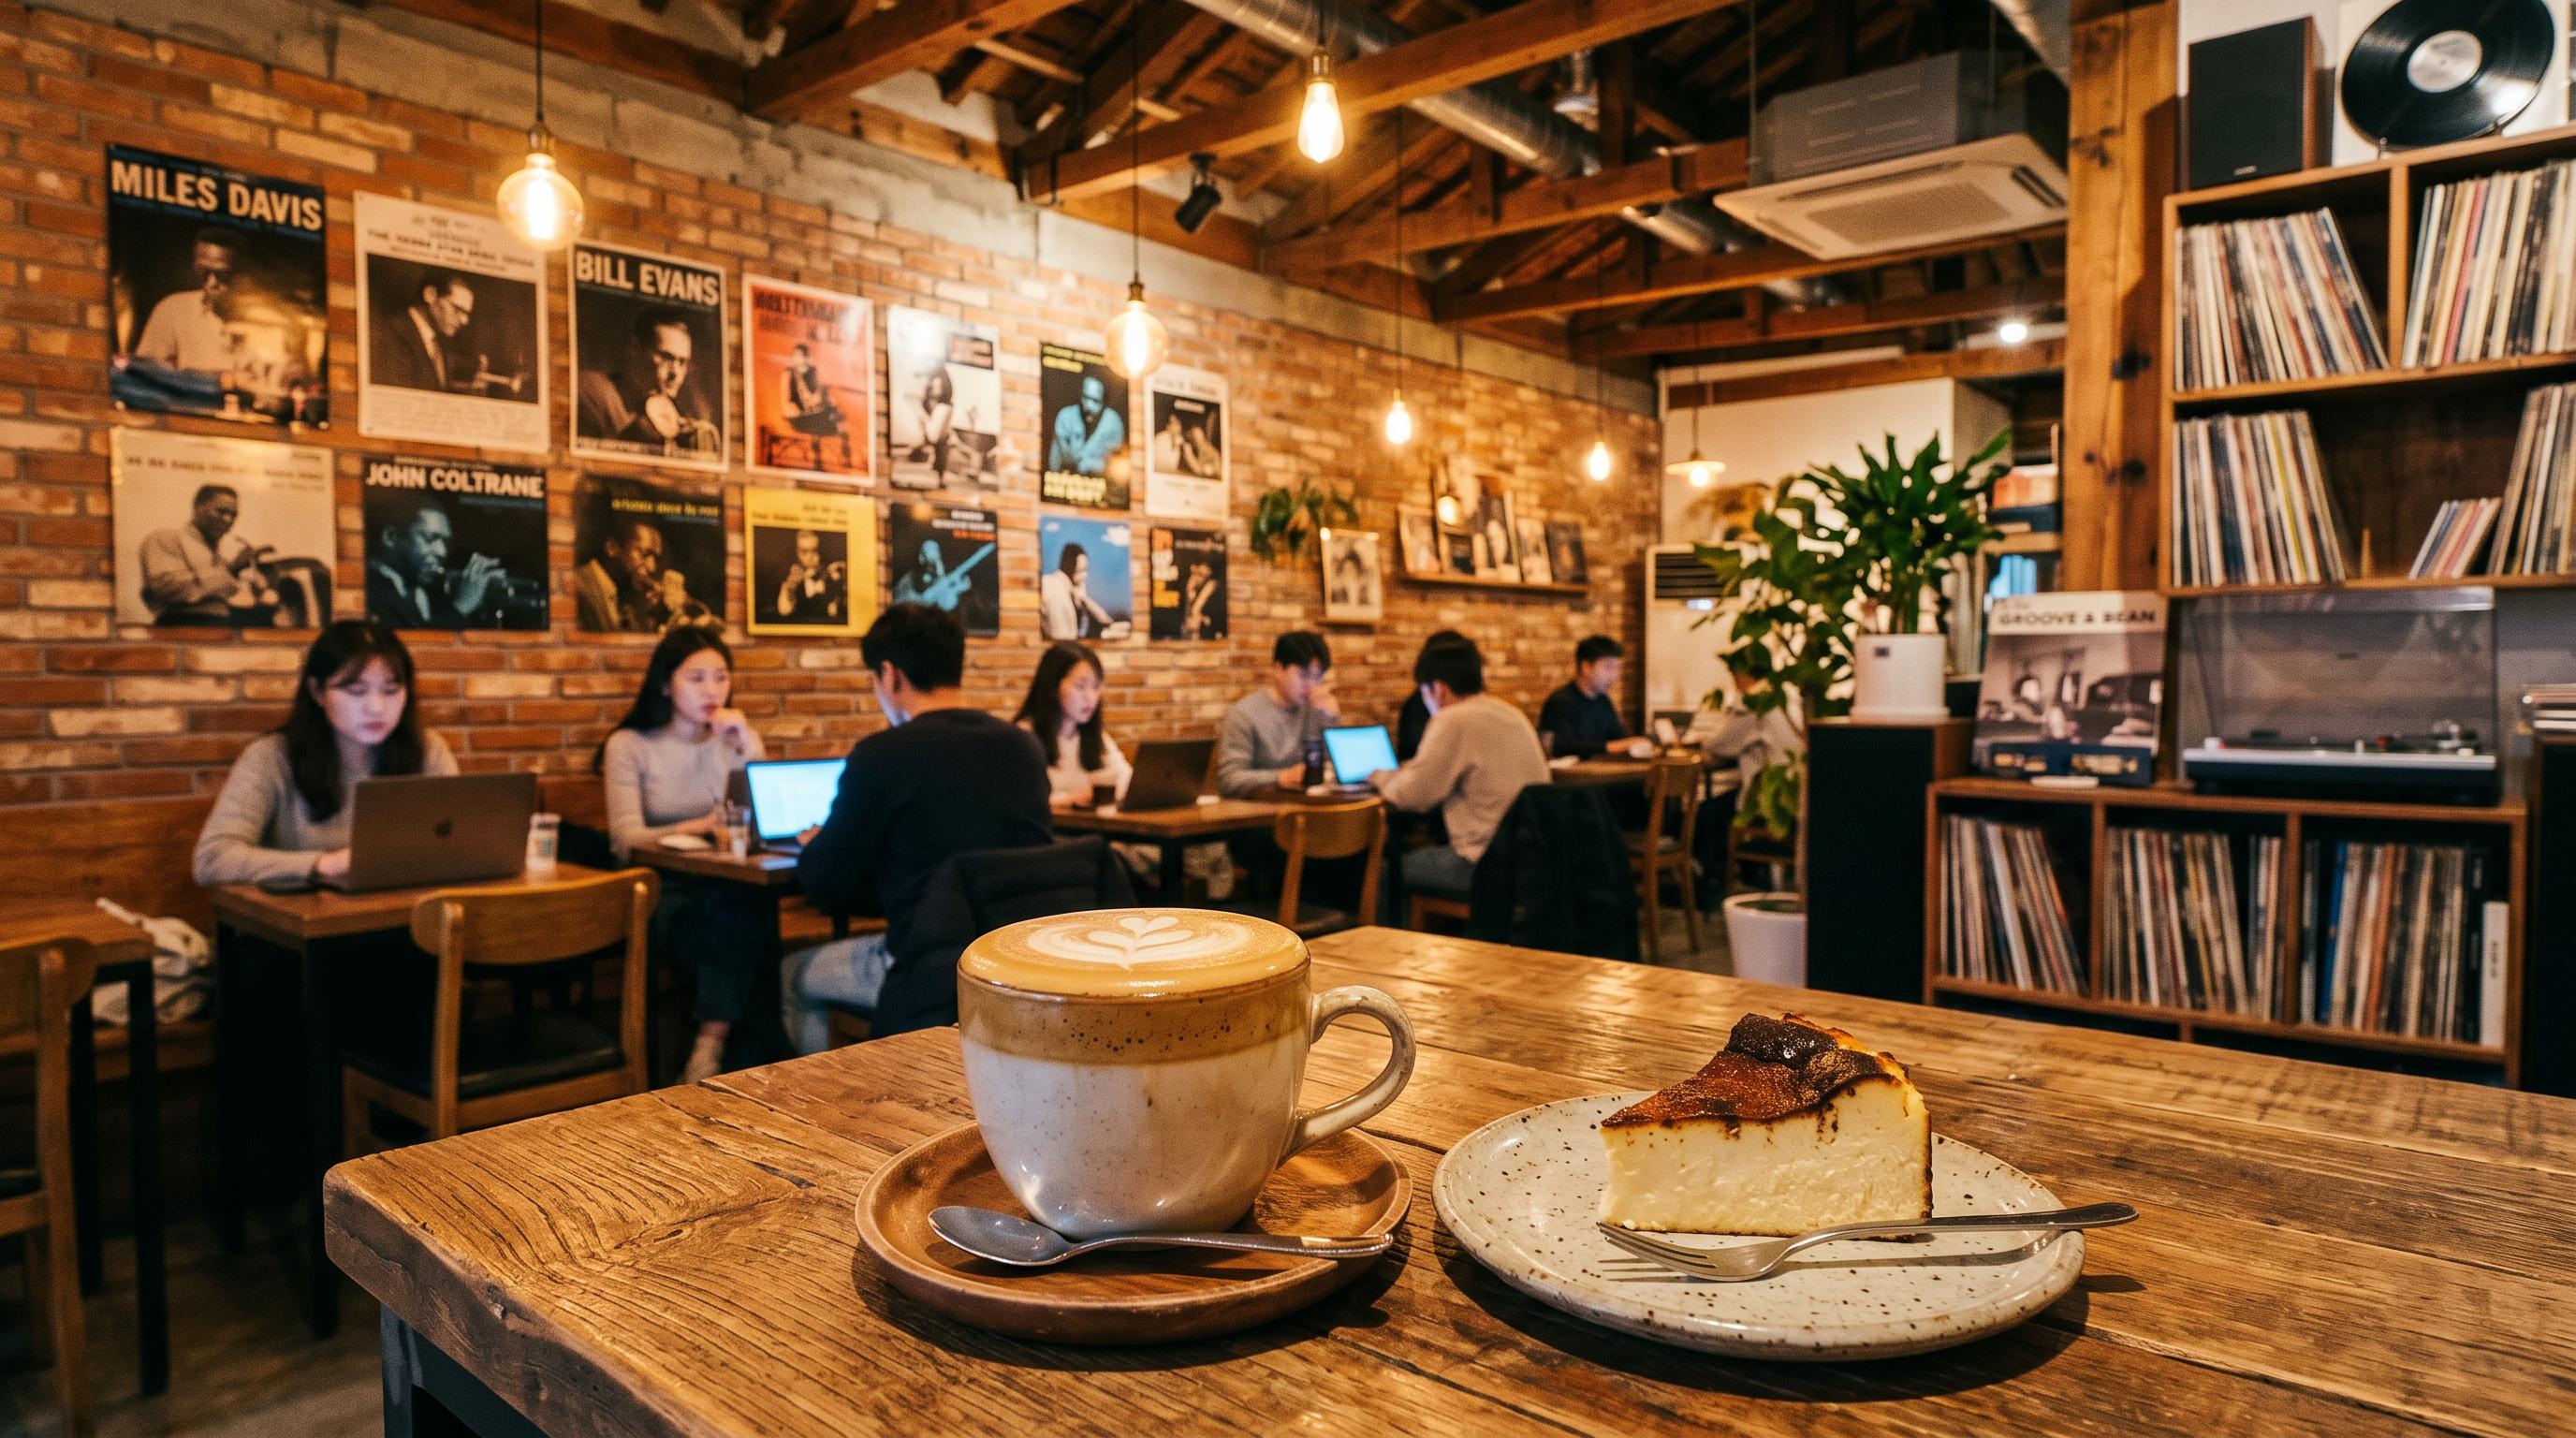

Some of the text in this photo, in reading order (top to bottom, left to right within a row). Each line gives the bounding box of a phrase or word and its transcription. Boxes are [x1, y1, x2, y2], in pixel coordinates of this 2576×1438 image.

[110, 159, 219, 212] MILES
[227, 182, 323, 231] DAVIS
[576, 250, 634, 290] BILL
[639, 262, 720, 306] EVANS
[365, 462, 427, 489] JOHN
[430, 469, 545, 499] COLTRANE
